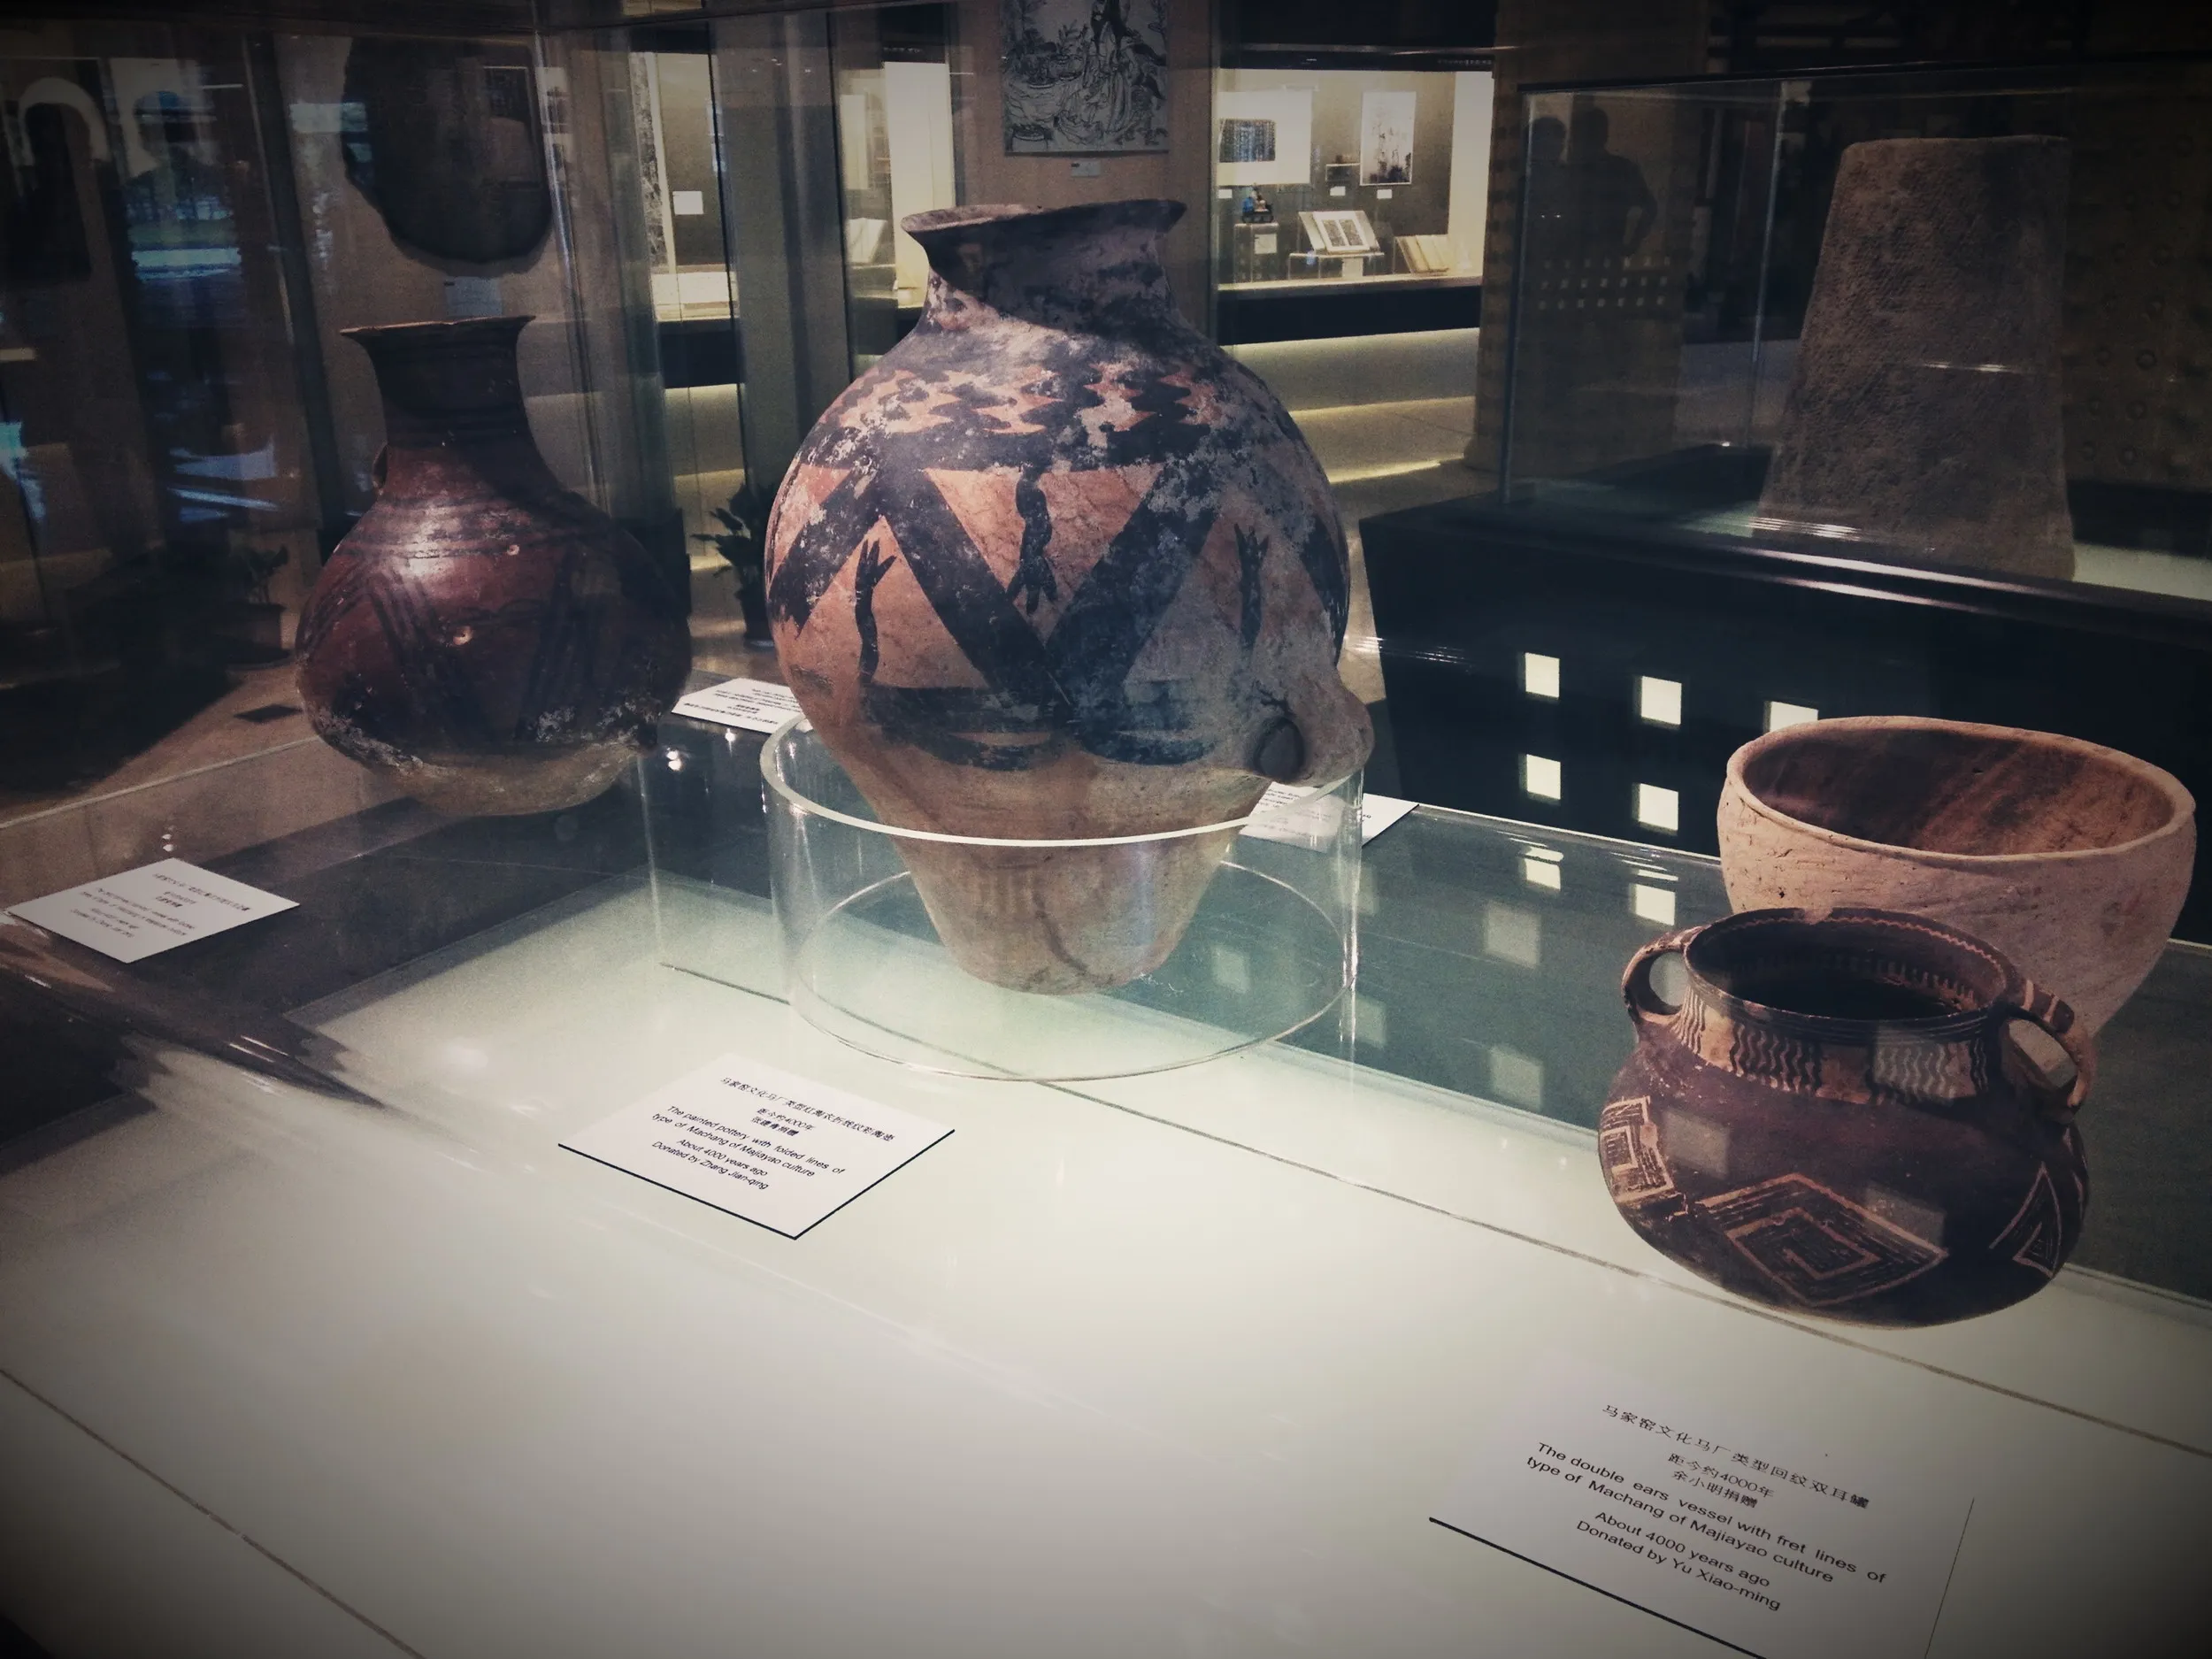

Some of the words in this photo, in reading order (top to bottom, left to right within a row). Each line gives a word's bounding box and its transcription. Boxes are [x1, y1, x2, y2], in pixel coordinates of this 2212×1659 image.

[652, 1113, 672, 1124] type
[687, 1125, 730, 1146] Machang
[740, 1145, 782, 1164] Majiayao
[781, 1161, 815, 1178] culture
[652, 1141, 689, 1159] Donated
[687, 1154, 701, 1164] by
[700, 1159, 729, 1175] Zhang
[728, 1171, 769, 1191] Jian-qing
[667, 1105, 684, 1116] The
[683, 1113, 720, 1128] painted
[716, 1125, 749, 1141] pottery
[752, 1138, 772, 1148] with
[806, 1156, 830, 1170] lines
[676, 1139, 704, 1152] About
[704, 1148, 727, 1161] 4000
[726, 1156, 750, 1170] years
[749, 1167, 768, 1177] ago
[1602, 1404, 1870, 1509] 马家窑文化马厂类型回纹双耳罐
[1668, 1453, 1774, 1498] 距今约4000年
[1526, 1455, 1561, 1476] type
[1564, 1472, 1583, 1484] of
[1588, 1480, 1665, 1519] Machang
[1669, 1514, 1688, 1525] of
[1689, 1519, 1768, 1557] Majiayao
[1772, 1554, 1834, 1583] culture
[1538, 1441, 1566, 1461] The
[1570, 1457, 1625, 1484] double
[1632, 1481, 1670, 1502] ears
[1678, 1499, 1733, 1525] vessel
[1737, 1521, 1771, 1540] with
[1776, 1535, 1807, 1554] fret
[1815, 1548, 1857, 1573] lines
[1867, 1571, 1886, 1583] of
[1671, 1470, 1758, 1509] 余小明捐赠
[1576, 1520, 1645, 1555] Donated
[1646, 1549, 1668, 1565] by
[1672, 1557, 1693, 1575] Yu
[1695, 1568, 1781, 1612] Xiao-ming
[1594, 1511, 1642, 1537] About
[1645, 1532, 1686, 1554] 4000
[1688, 1549, 1734, 1573] years
[1738, 1570, 1770, 1587] ago
